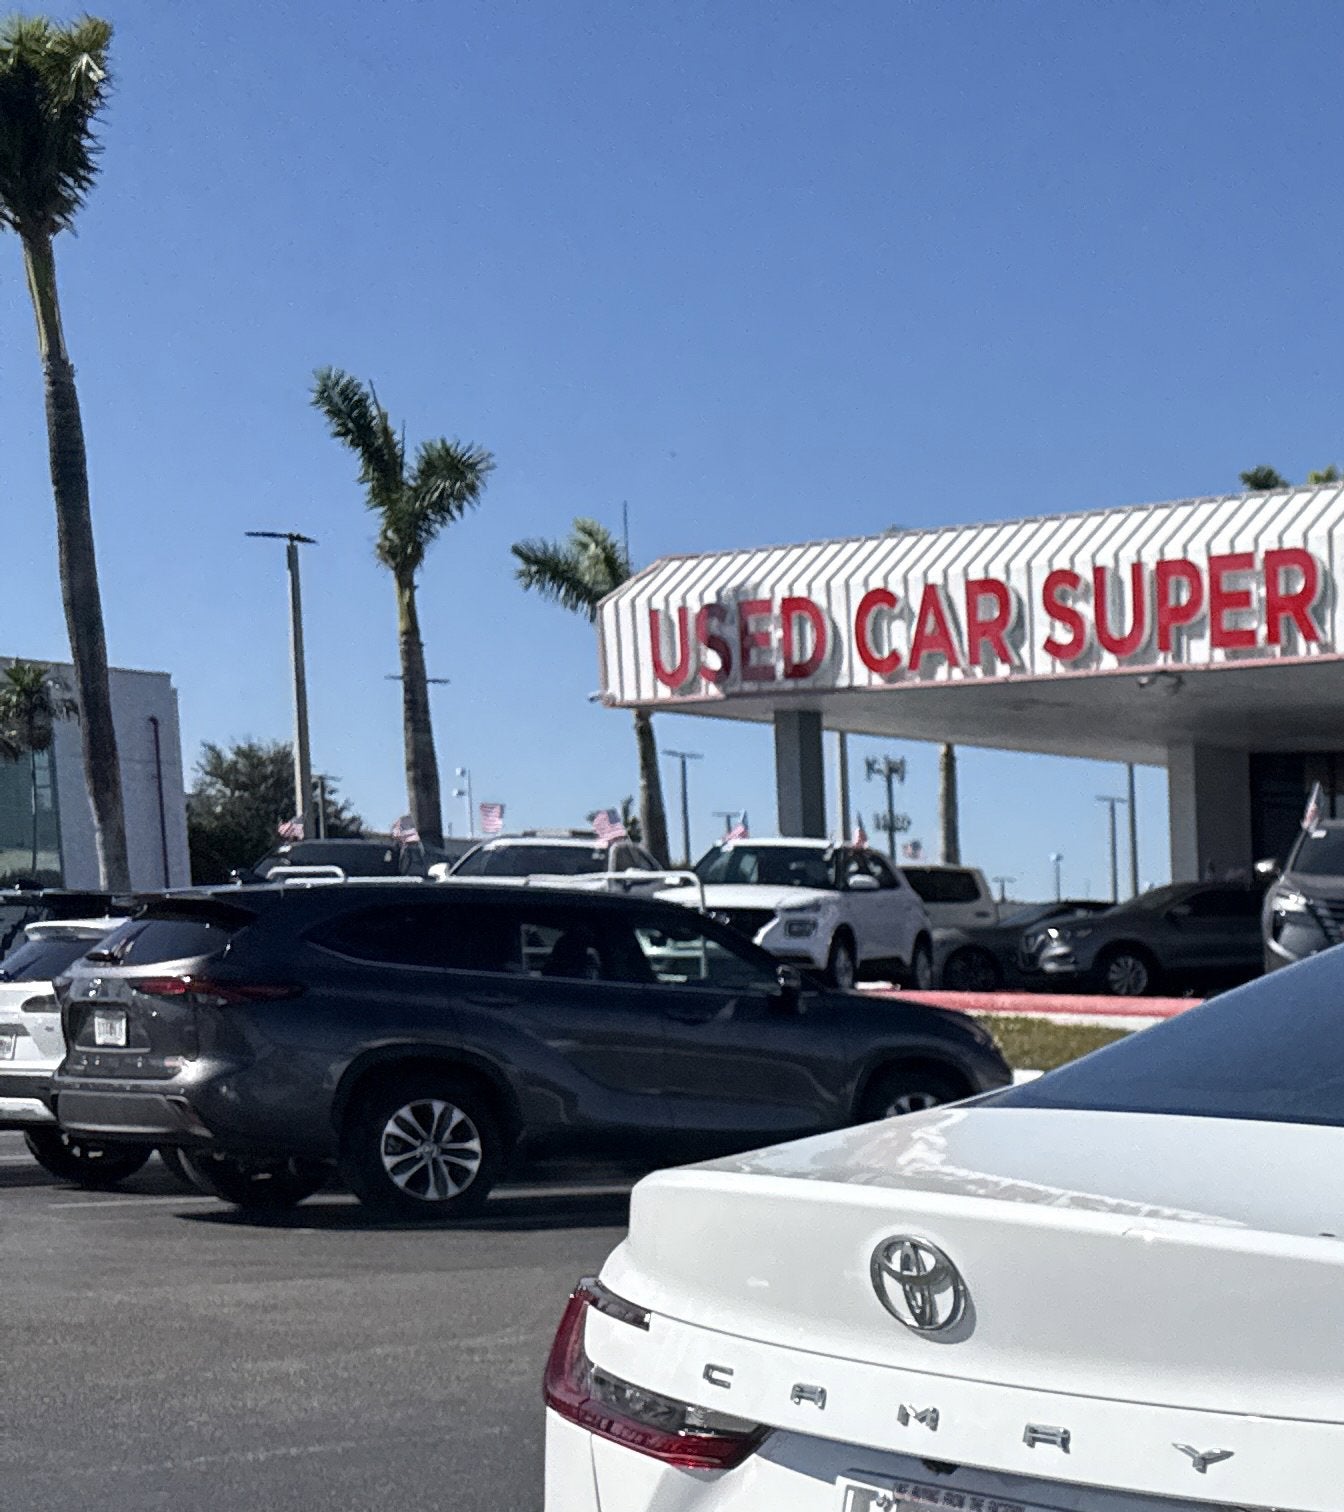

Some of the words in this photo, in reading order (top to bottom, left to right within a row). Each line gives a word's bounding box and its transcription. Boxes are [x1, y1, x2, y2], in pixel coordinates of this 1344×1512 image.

[650, 596, 828, 689] USED
[855, 578, 1014, 675] CAR
[1043, 548, 1320, 661] SUPER
